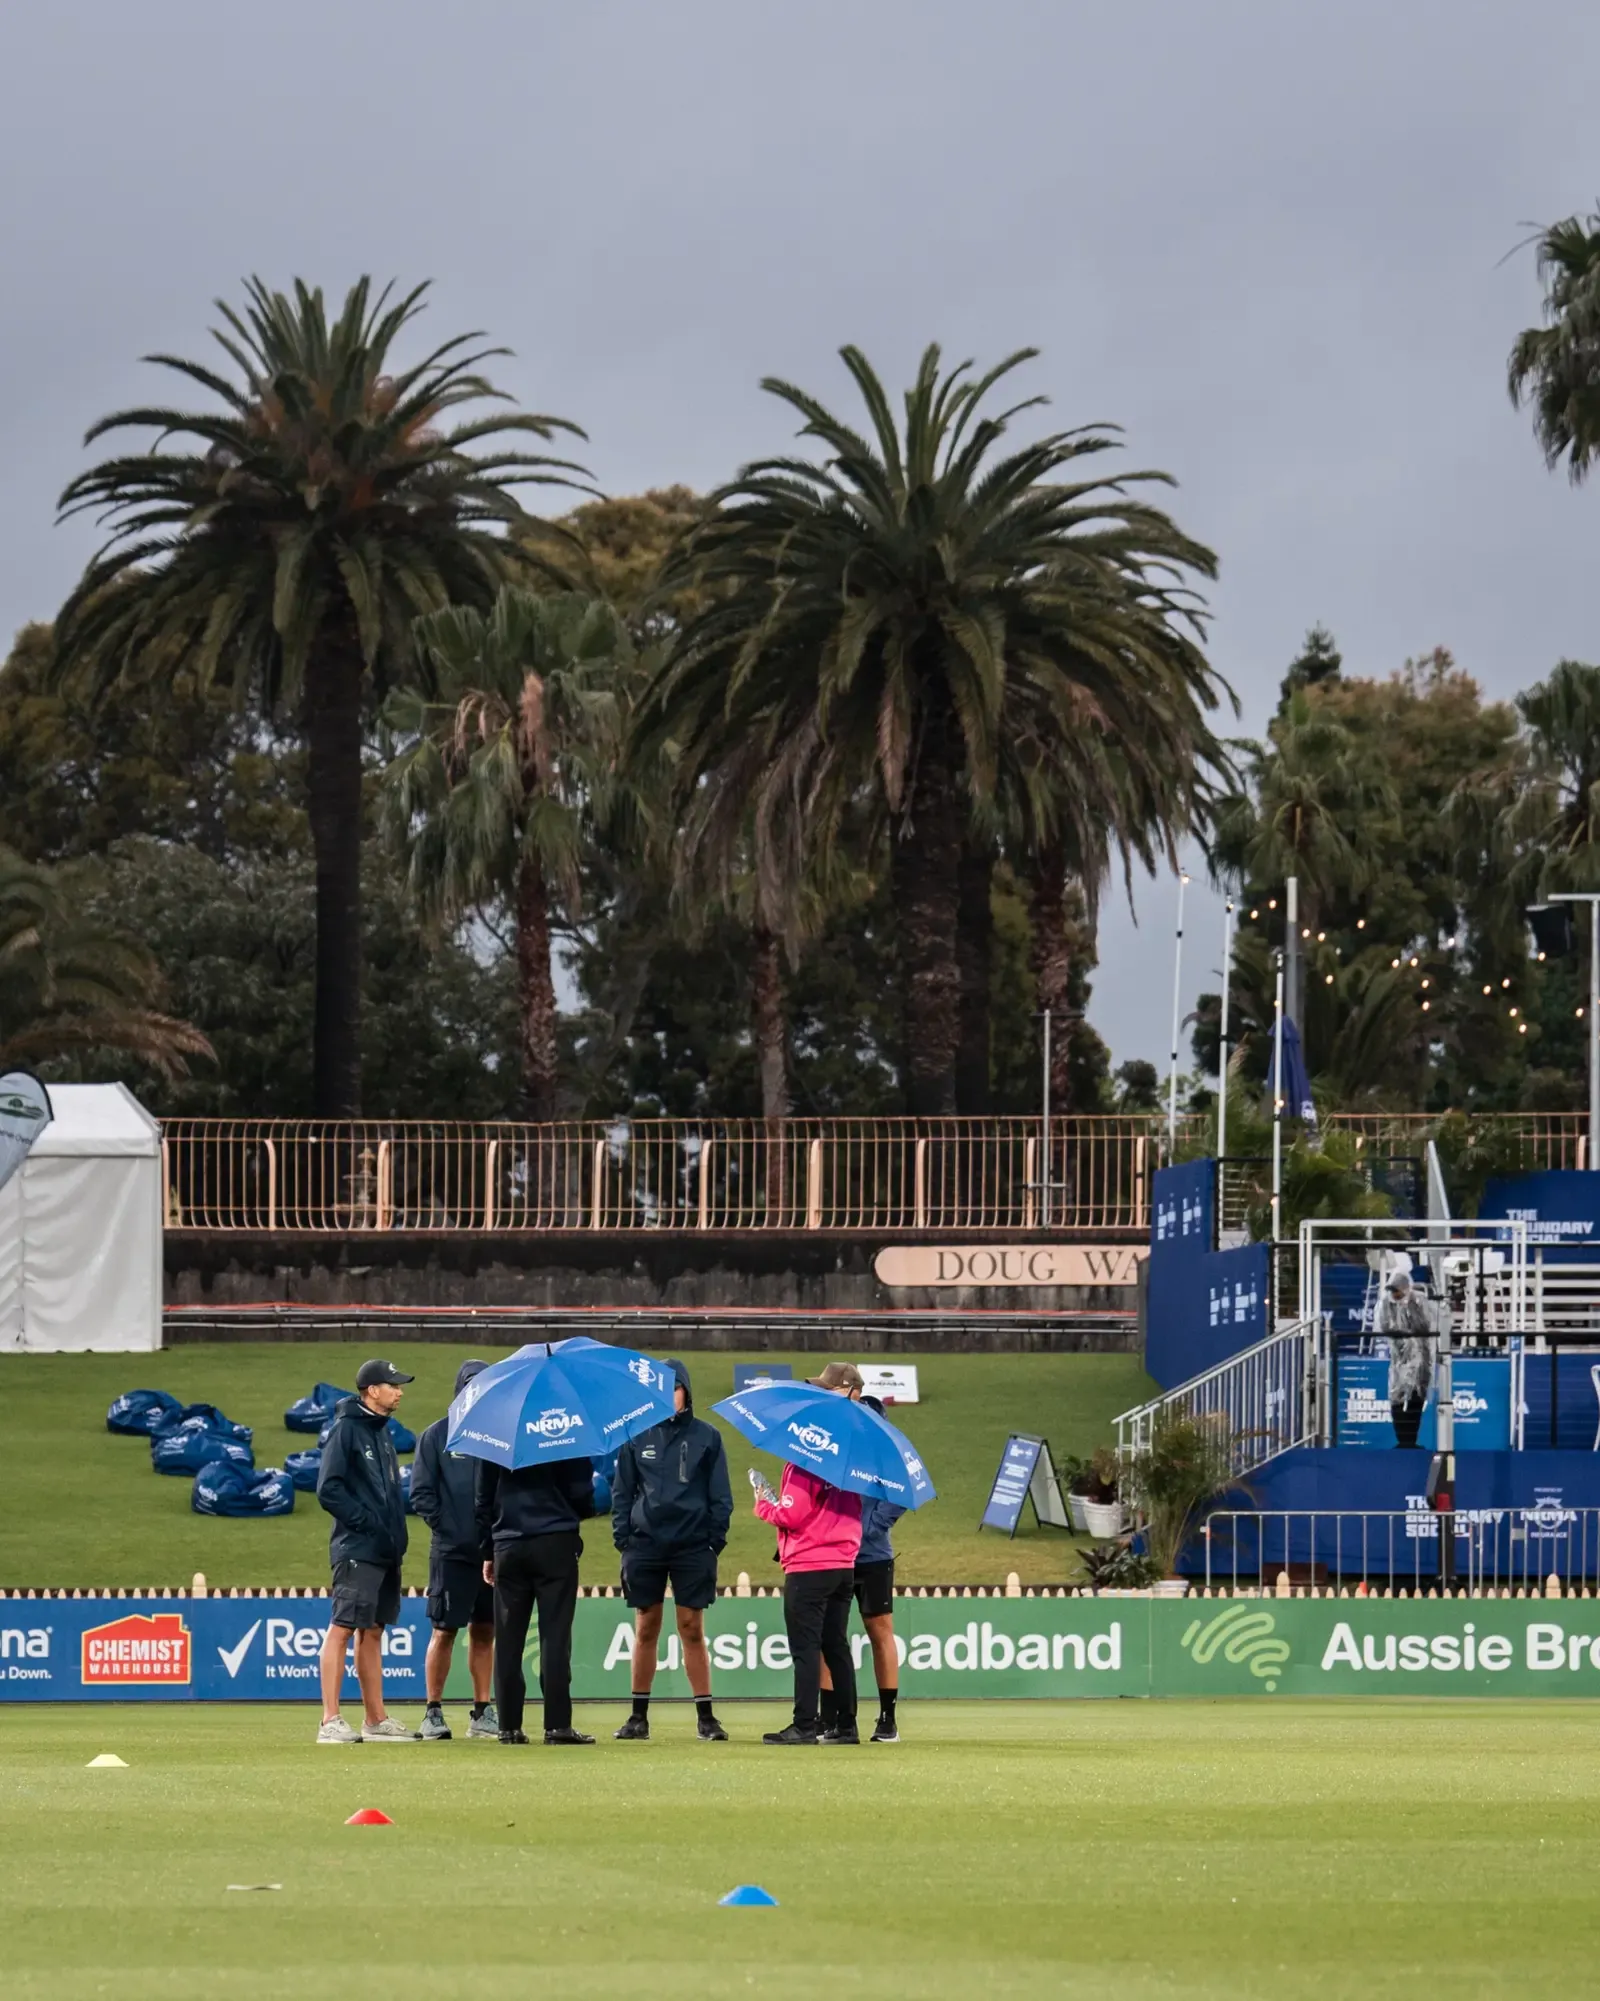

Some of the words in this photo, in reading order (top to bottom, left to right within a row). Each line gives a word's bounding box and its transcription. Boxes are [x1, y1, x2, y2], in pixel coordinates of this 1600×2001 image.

[1506, 1209, 1538, 1221] THE
[1508, 1221, 1595, 1235] UNDARY
[935, 1251, 1057, 1281] DOUG
[1346, 1388, 1377, 1400] THE
[1452, 1398, 1489, 1411] RMA
[525, 1413, 584, 1435] NRMA
[603, 1426, 610, 1435] A
[607, 1418, 625, 1431] Help
[622, 1401, 655, 1422] Company
[461, 1429, 468, 1437] A
[468, 1431, 483, 1442] Help
[482, 1434, 511, 1451] Company
[538, 1437, 577, 1449] INSURANCE
[787, 1421, 839, 1456] NRMA
[788, 1443, 824, 1464] INSURANCE
[850, 1469, 857, 1477] A
[856, 1470, 873, 1483] Help
[1405, 1495, 1430, 1509] TH
[89, 1639, 184, 1661] CHEMIST
[603, 1621, 795, 1671] Ausie
[1321, 1622, 1514, 1672] Aussie
[8, 1666, 52, 1680] Down.
[89, 1663, 182, 1675] WAREHOUSE
[266, 1665, 276, 1678] It
[278, 1665, 319, 1678] Won't
[345, 1666, 359, 1678] Yo
[382, 1667, 416, 1678] own.
